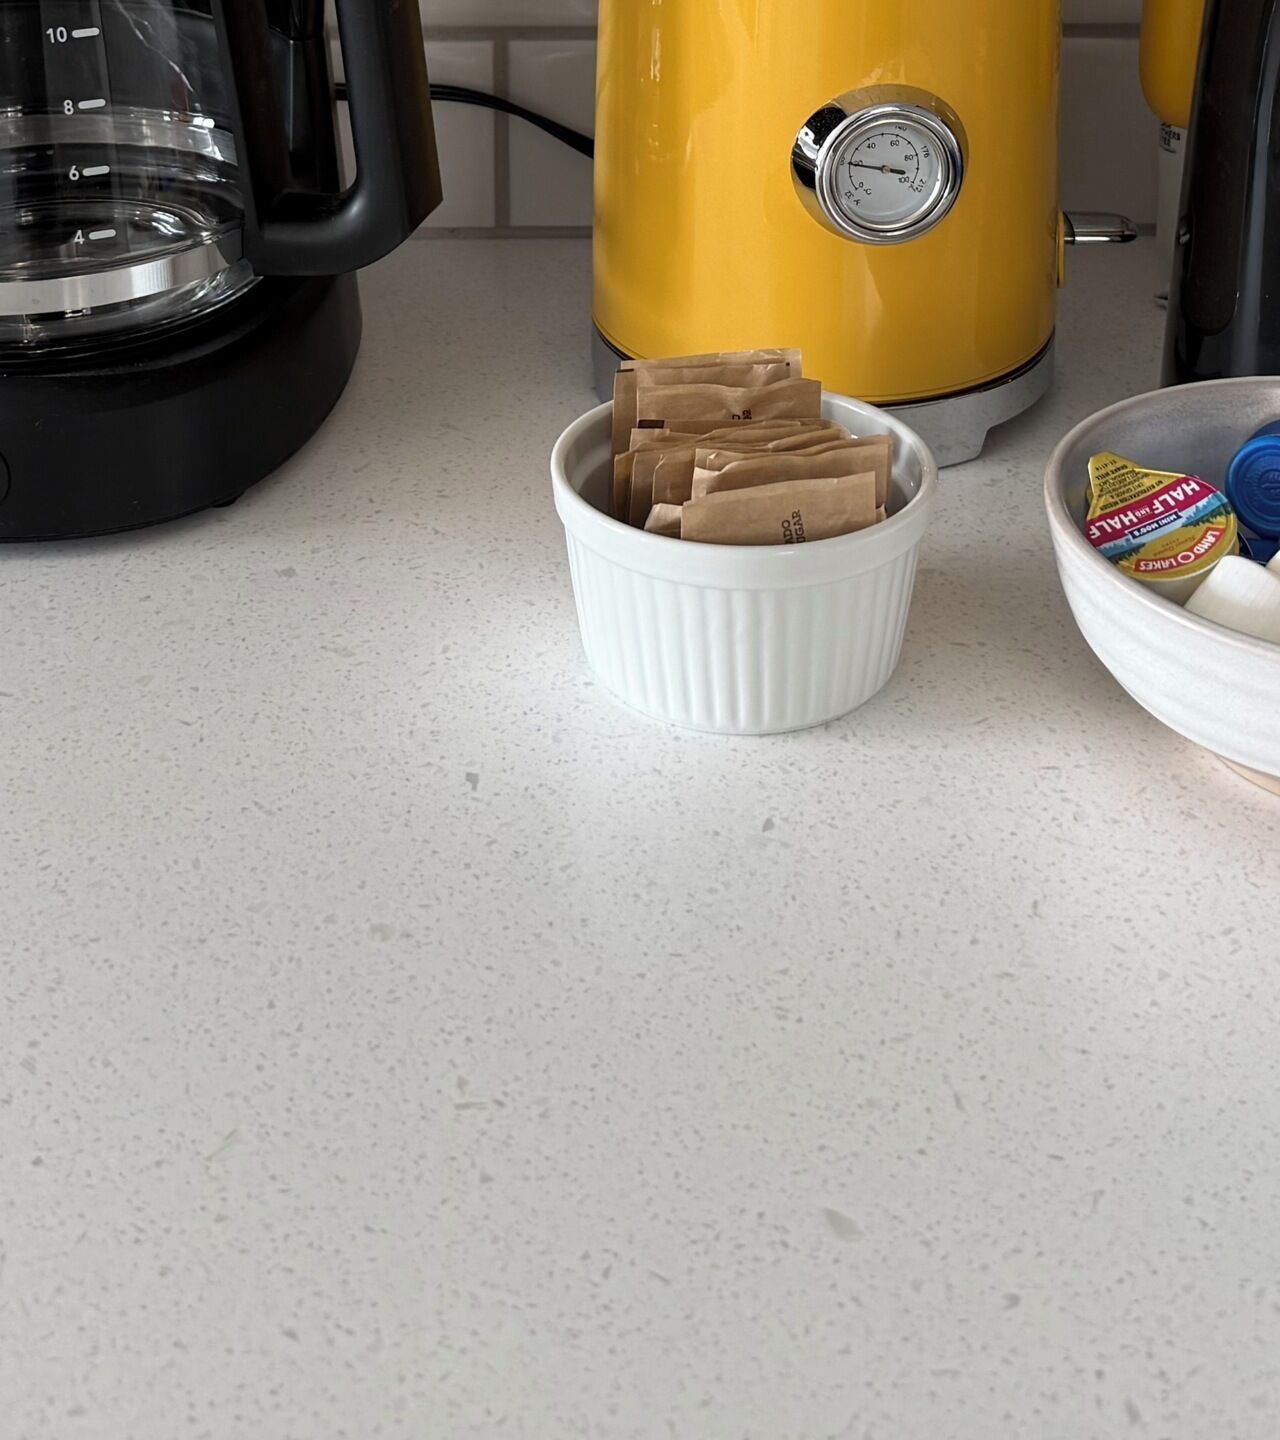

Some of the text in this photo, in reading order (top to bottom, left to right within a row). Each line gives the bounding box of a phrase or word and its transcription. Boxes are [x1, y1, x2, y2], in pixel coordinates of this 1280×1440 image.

[45, 26, 68, 44] 10
[63, 99, 74, 115] 8
[904, 154, 914, 162] 80
[68, 165, 80, 181] 6
[73, 229, 85, 244] 4
[1153, 480, 1200, 514] HALF
[792, 509, 806, 544] UGAR
[1089, 511, 1138, 539] HALF
[1134, 513, 1178, 537] MINI MOO'S
[1194, 530, 1220, 555] LAND
[1139, 557, 1177, 571] LAKES
[1177, 551, 1195, 563] O
